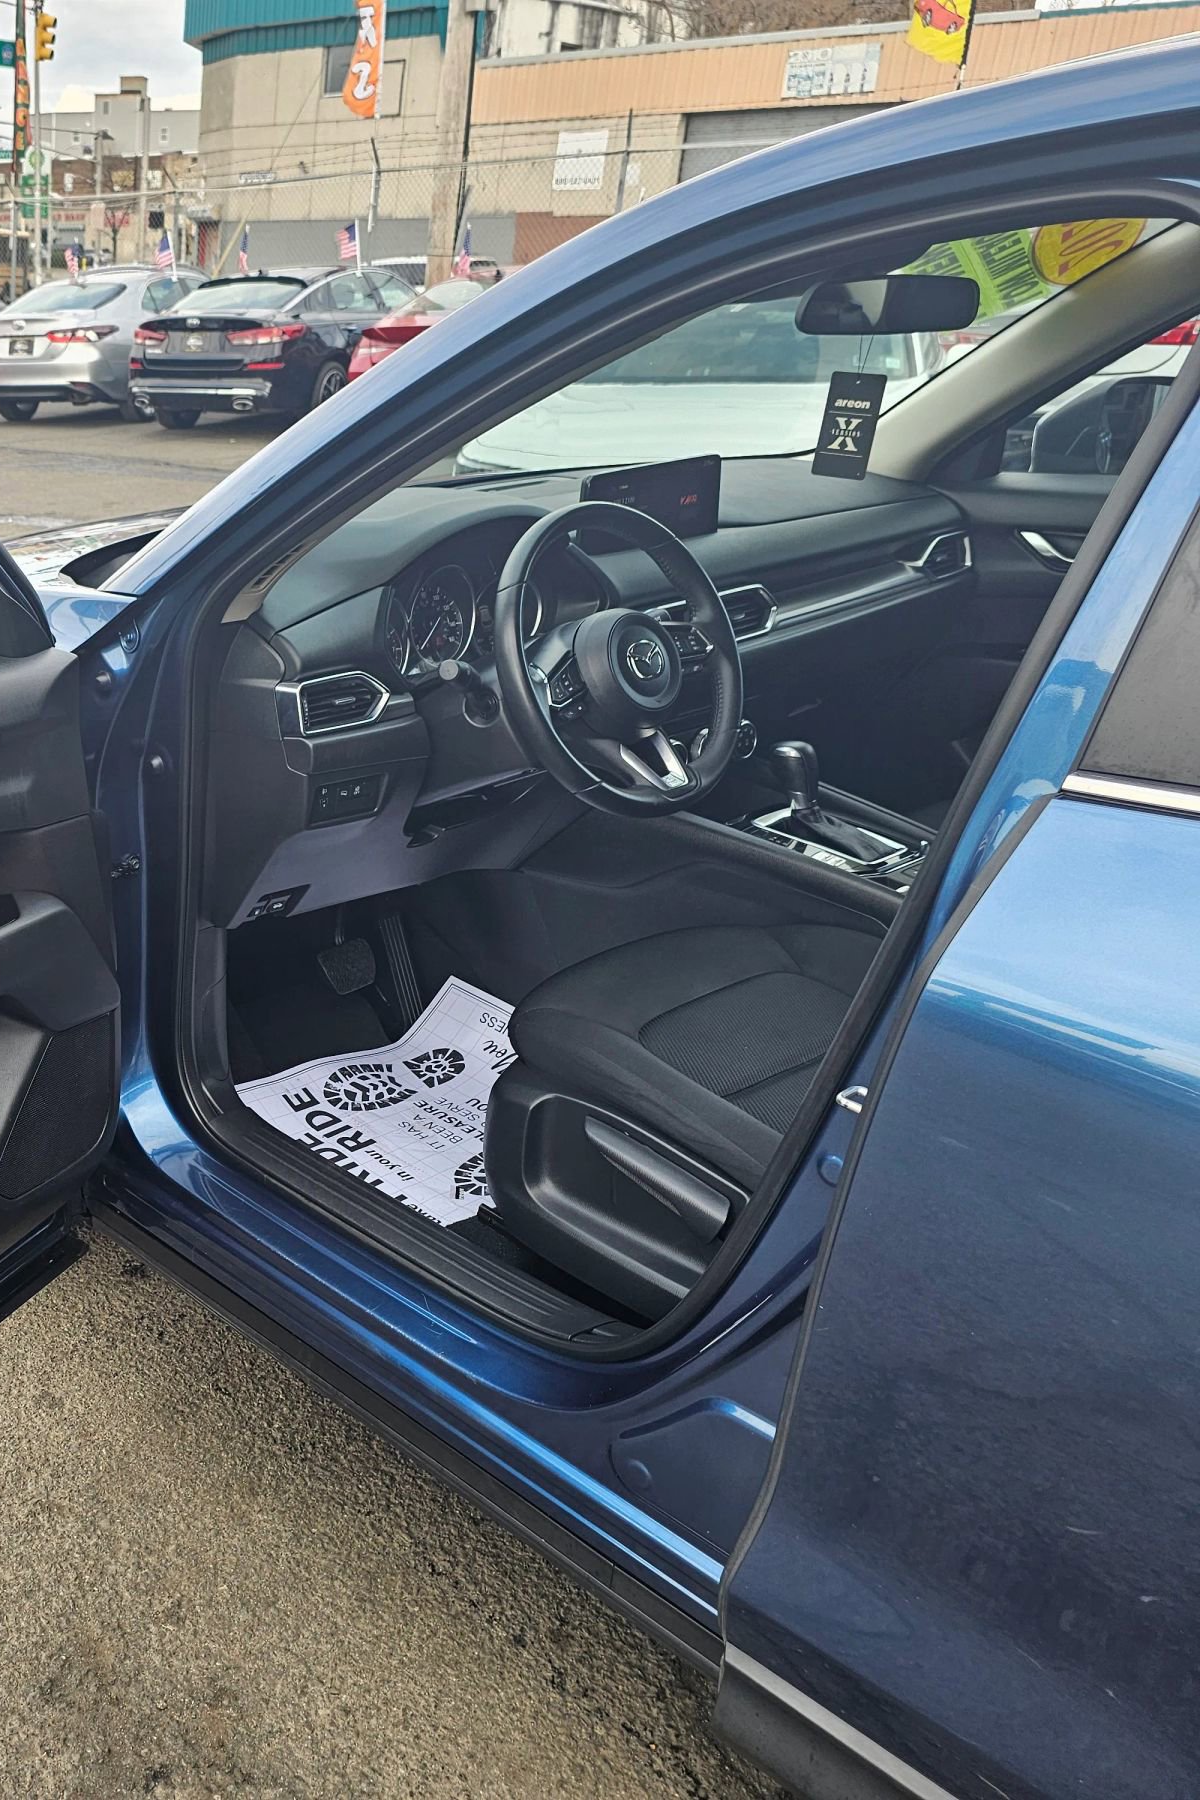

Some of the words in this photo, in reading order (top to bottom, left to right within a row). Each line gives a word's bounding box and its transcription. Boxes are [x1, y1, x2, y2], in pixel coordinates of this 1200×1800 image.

[834, 398, 871, 410] areon
[479, 1012, 508, 1035] ESS
[434, 1096, 480, 1122] SERVE
[465, 1098, 488, 1114] OU
[281, 1087, 377, 1153] RIDE
[413, 1113, 426, 1122] A
[398, 1121, 429, 1140] HAS
[424, 1121, 463, 1144] BEEN
[427, 1140, 446, 1150] IT
[304, 1132, 408, 1205] RIDE
[365, 1149, 402, 1170] your
[397, 1170, 415, 1182] in
